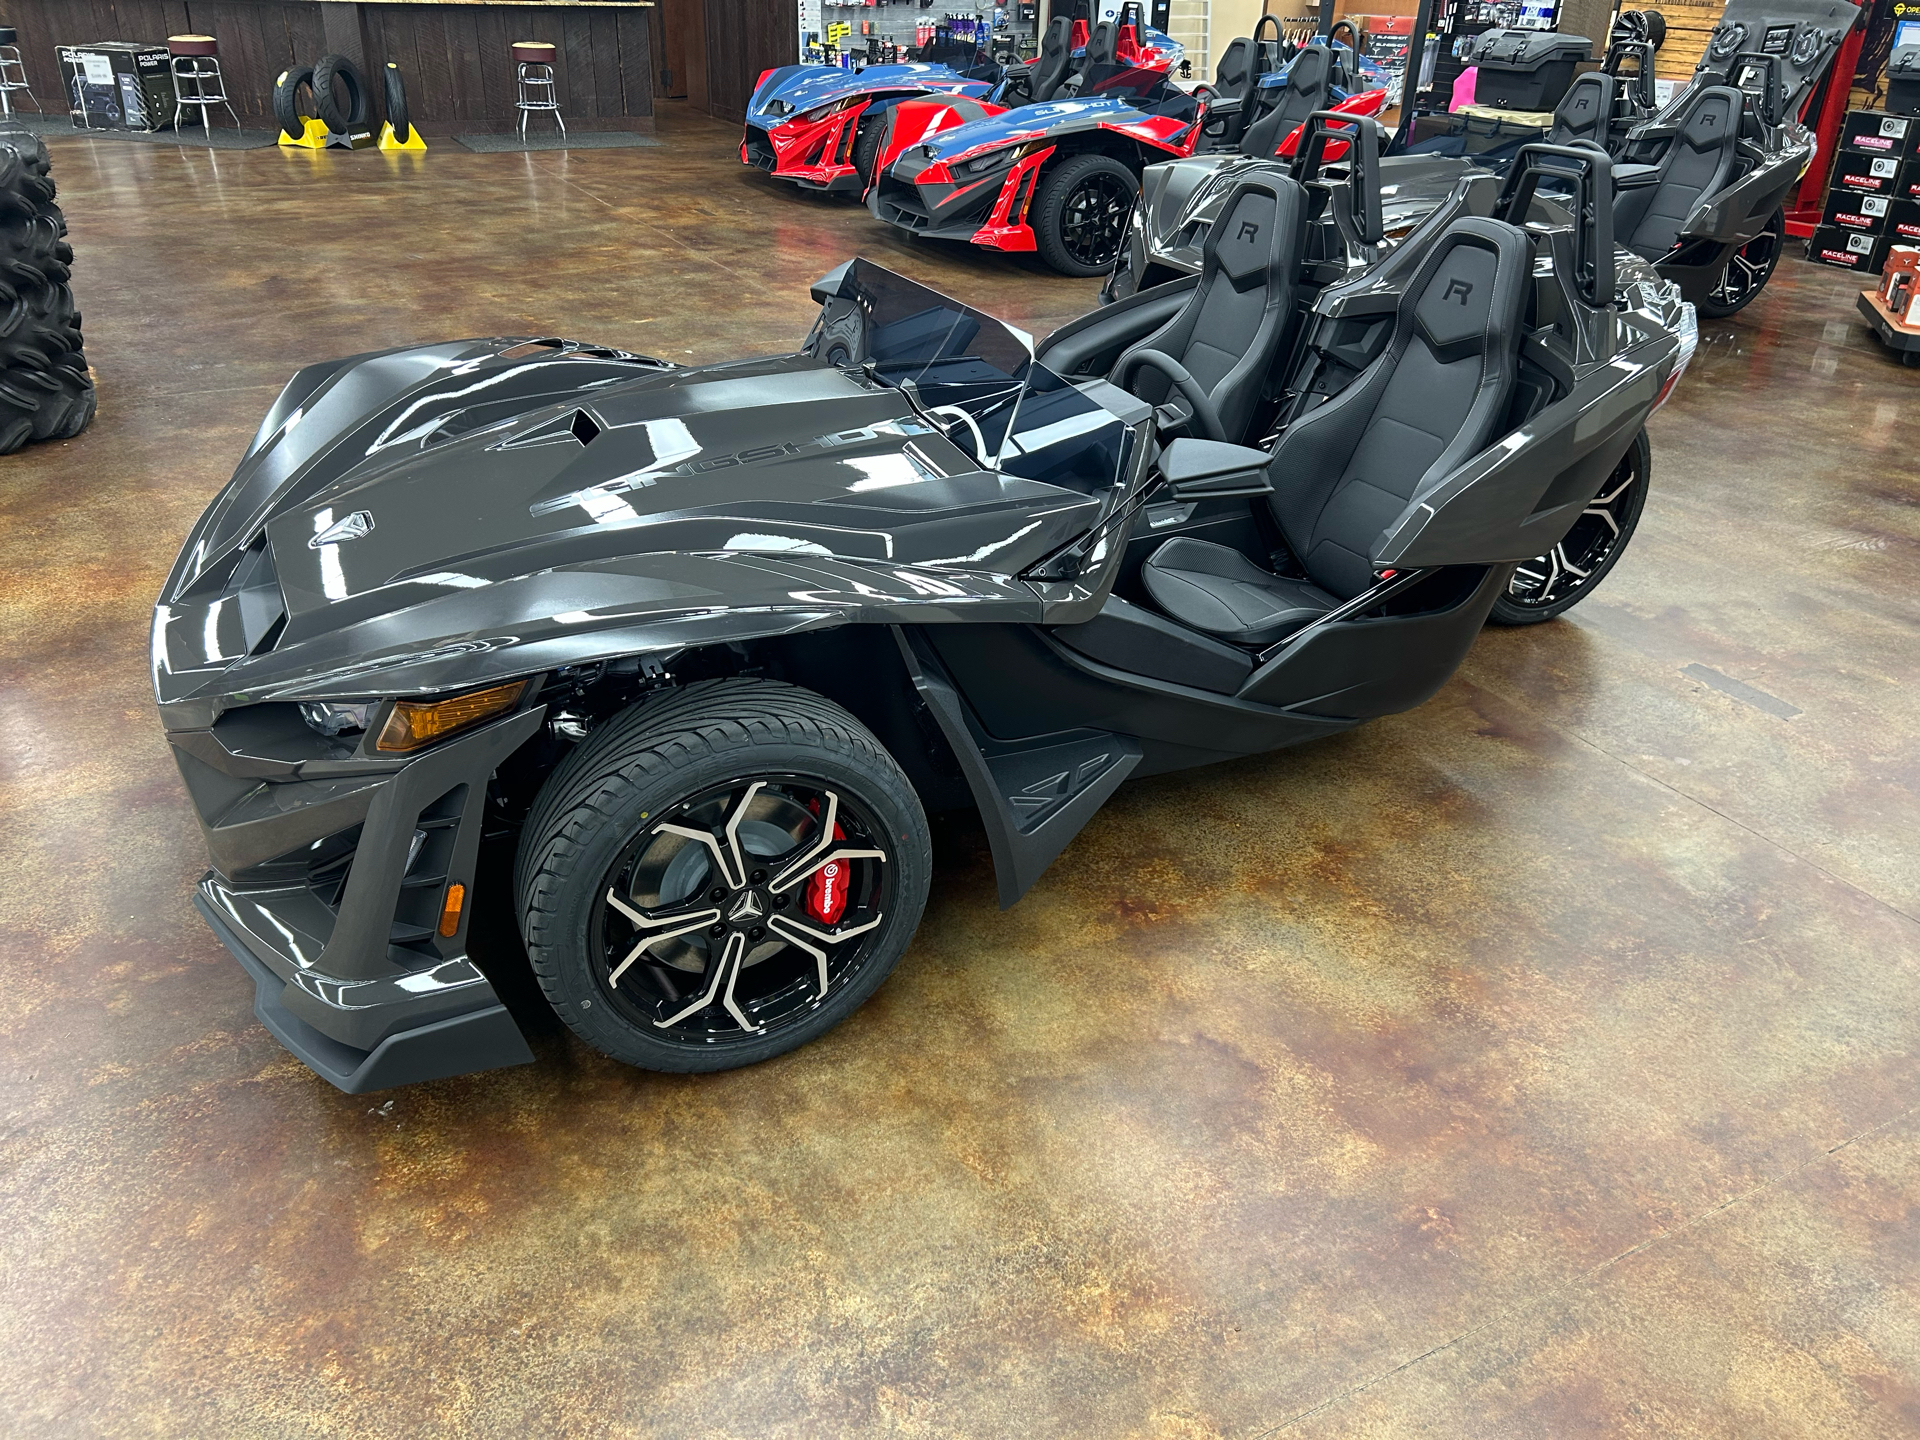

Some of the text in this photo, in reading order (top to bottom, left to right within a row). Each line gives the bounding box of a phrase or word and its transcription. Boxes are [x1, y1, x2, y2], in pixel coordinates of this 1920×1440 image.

[1574, 99, 1589, 110] R
[1699, 114, 1717, 127] R
[1855, 135, 1893, 146] RACELINE
[1844, 175, 1882, 186] RACELINE
[1836, 213, 1873, 224] RACELINE
[1236, 220, 1260, 244] R
[1822, 249, 1859, 262] RACELINE
[1442, 278, 1474, 306] R
[823, 877, 835, 914] brembo
